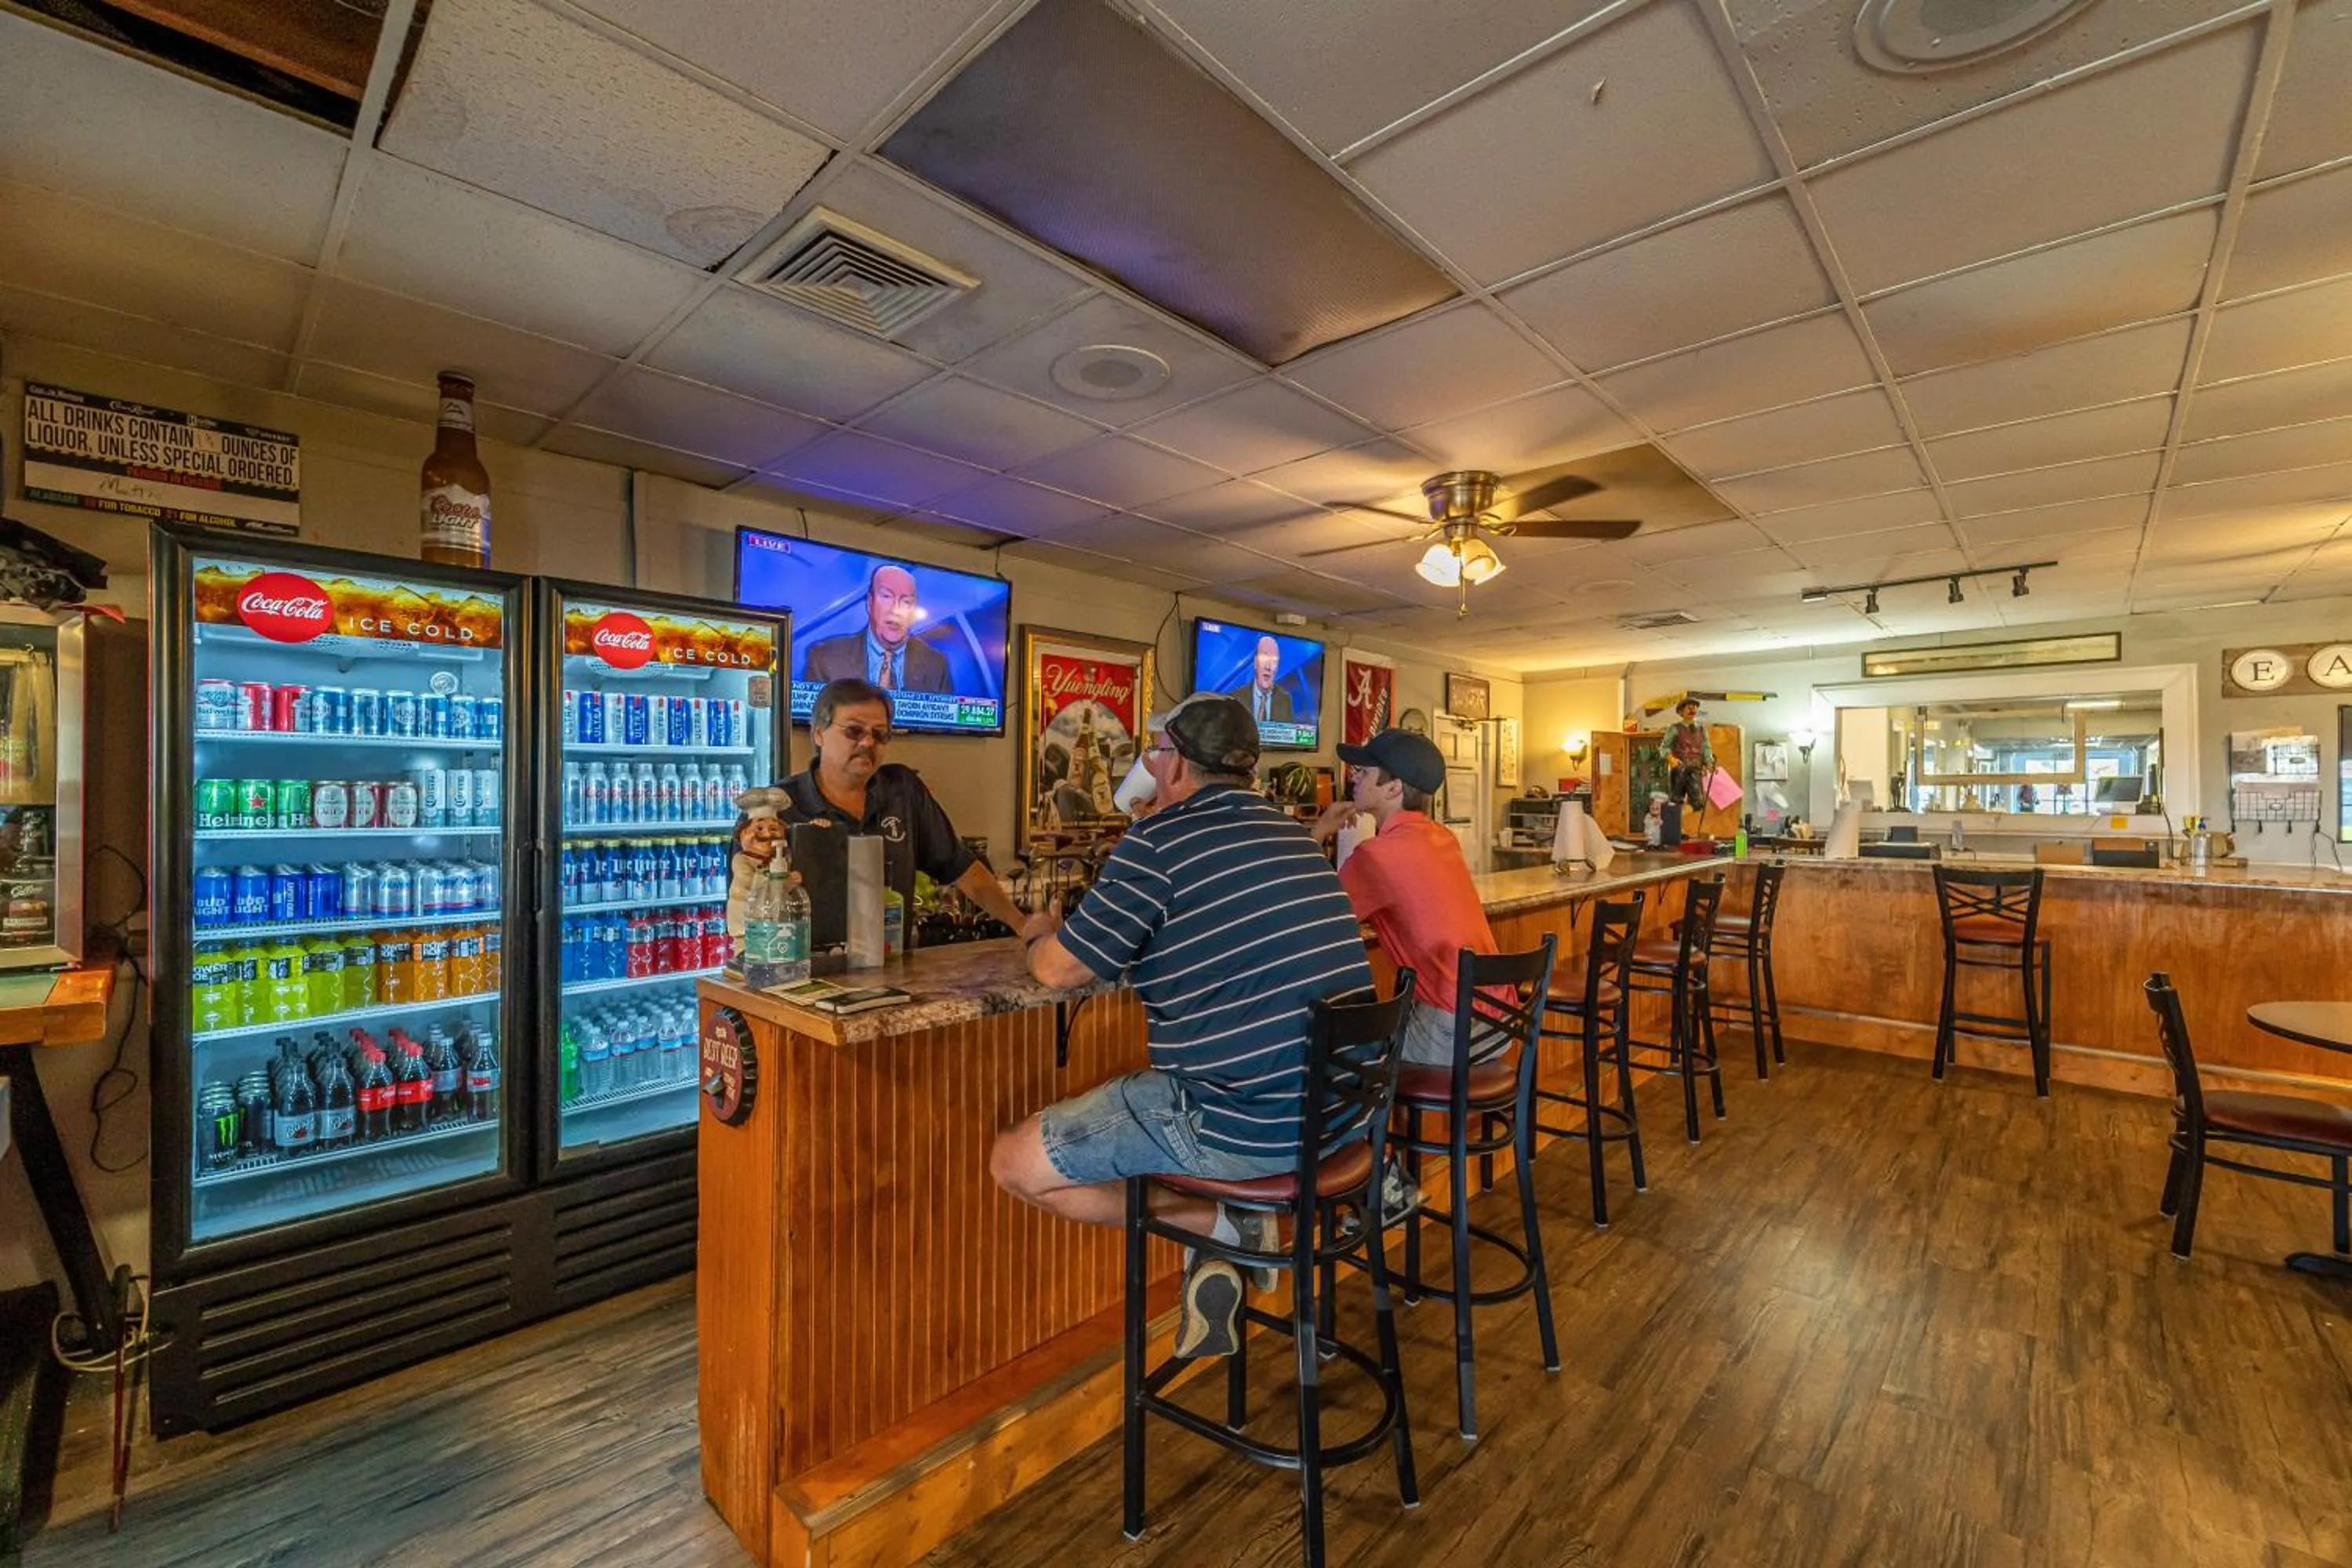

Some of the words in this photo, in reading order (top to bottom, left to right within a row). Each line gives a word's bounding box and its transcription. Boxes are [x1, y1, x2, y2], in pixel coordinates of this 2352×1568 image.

[27, 399, 58, 424] ALL
[64, 406, 124, 435] DRINKS
[129, 418, 194, 448] CONTAIN
[222, 436, 277, 463] OUNCES
[280, 447, 297, 466] OF
[27, 422, 93, 452] LIQUOR.
[99, 434, 158, 463] UNLESS
[163, 446, 224, 474] SPECIAL
[228, 458, 296, 487] ORDERED.
[99, 500, 117, 510] FOR
[120, 503, 161, 517] TOBACCO
[180, 513, 197, 524] FOR
[198, 514, 238, 528] ALCOHOL
[432, 513, 478, 529] LIGHT
[349, 616, 392, 633] ICE
[407, 622, 474, 640] COLD
[666, 647, 696, 660] ICE
[706, 652, 750, 665] COLD
[1046, 664, 1132, 705] Yuengling
[593, 705, 602, 738] ULTRA
[634, 707, 643, 738] ULTRA
